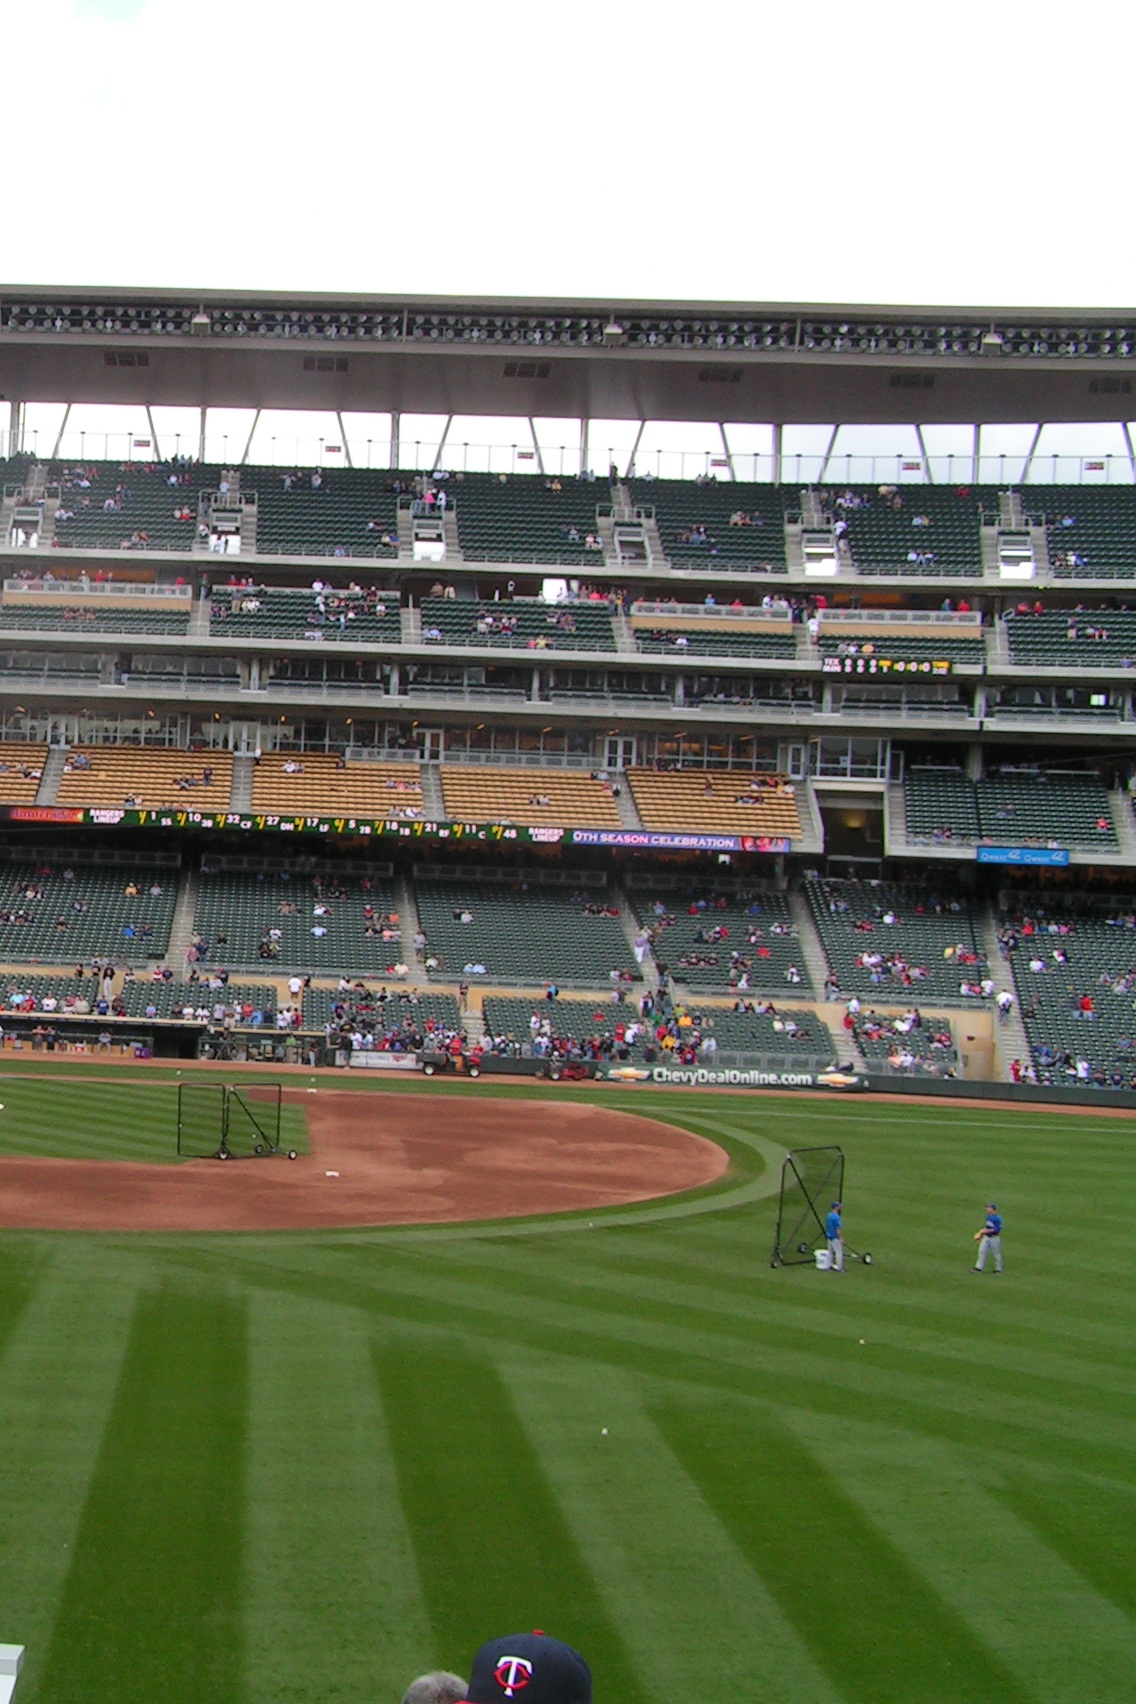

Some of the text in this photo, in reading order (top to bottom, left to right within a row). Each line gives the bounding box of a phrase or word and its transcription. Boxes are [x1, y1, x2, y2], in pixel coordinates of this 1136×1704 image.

[89, 809, 125, 817] RANGERS
[93, 816, 121, 824] LINEUP
[188, 813, 201, 822] 10
[227, 814, 240, 824] 32
[240, 821, 252, 829] CF
[266, 816, 280, 825] 27
[280, 822, 294, 831] DH
[306, 818, 319, 827] 17
[424, 824, 437, 832] 21
[465, 825, 476, 833] 11
[528, 828, 564, 836] RANGERS
[600, 833, 649, 845] SEASON
[651, 836, 735, 848] CELEBRATION
[653, 1067, 812, 1086] ChevyDealOnline.com
